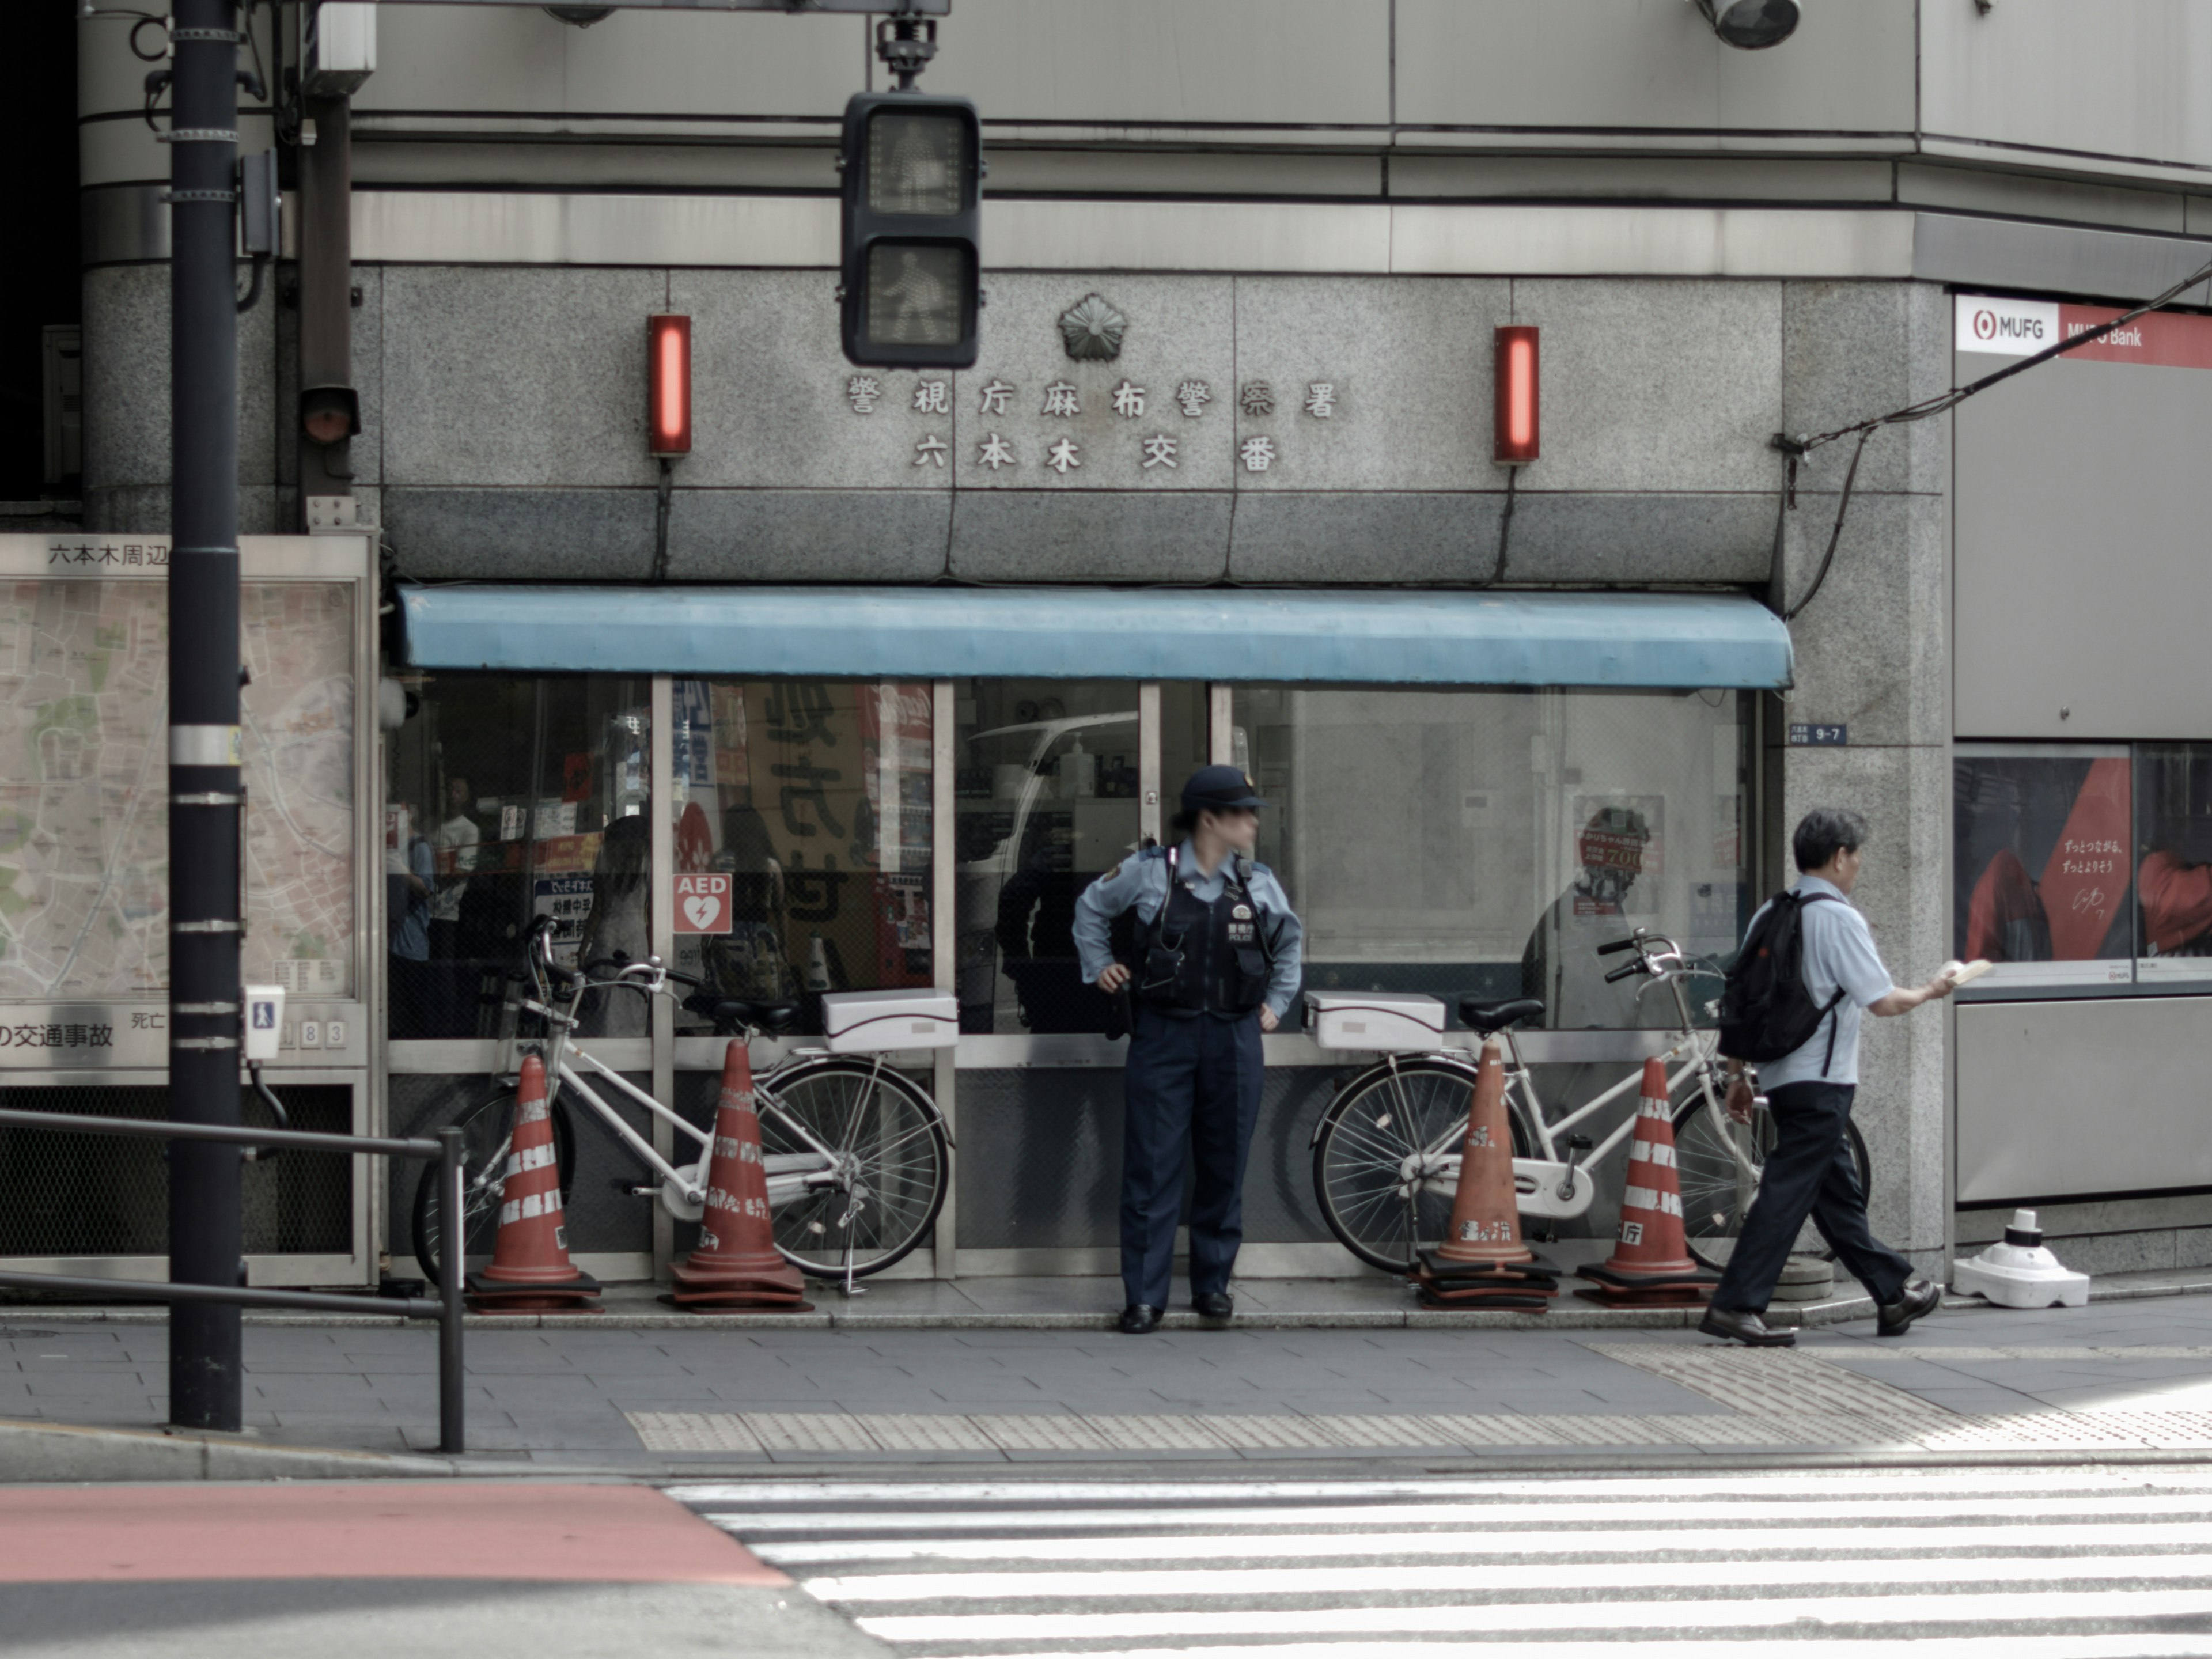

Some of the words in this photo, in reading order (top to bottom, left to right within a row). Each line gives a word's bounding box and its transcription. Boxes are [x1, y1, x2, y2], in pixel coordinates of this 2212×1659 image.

[1999, 317, 2043, 339] MUFG
[2110, 327, 2142, 347] Bank
[847, 376, 1338, 419] 警視庁麻布警察署
[914, 434, 1277, 473] 六本木交番
[48, 543, 169, 566] 六本木周辺
[1816, 729, 1839, 740] 9-7
[1607, 848, 1644, 866] 700
[2062, 859, 2113, 874] ずっとよりそう
[677, 877, 727, 895] AED
[1229, 934, 1253, 942] POLICE
[131, 1012, 165, 1029] 死亡
[306, 1025, 316, 1041] 8
[332, 1025, 341, 1041] 3
